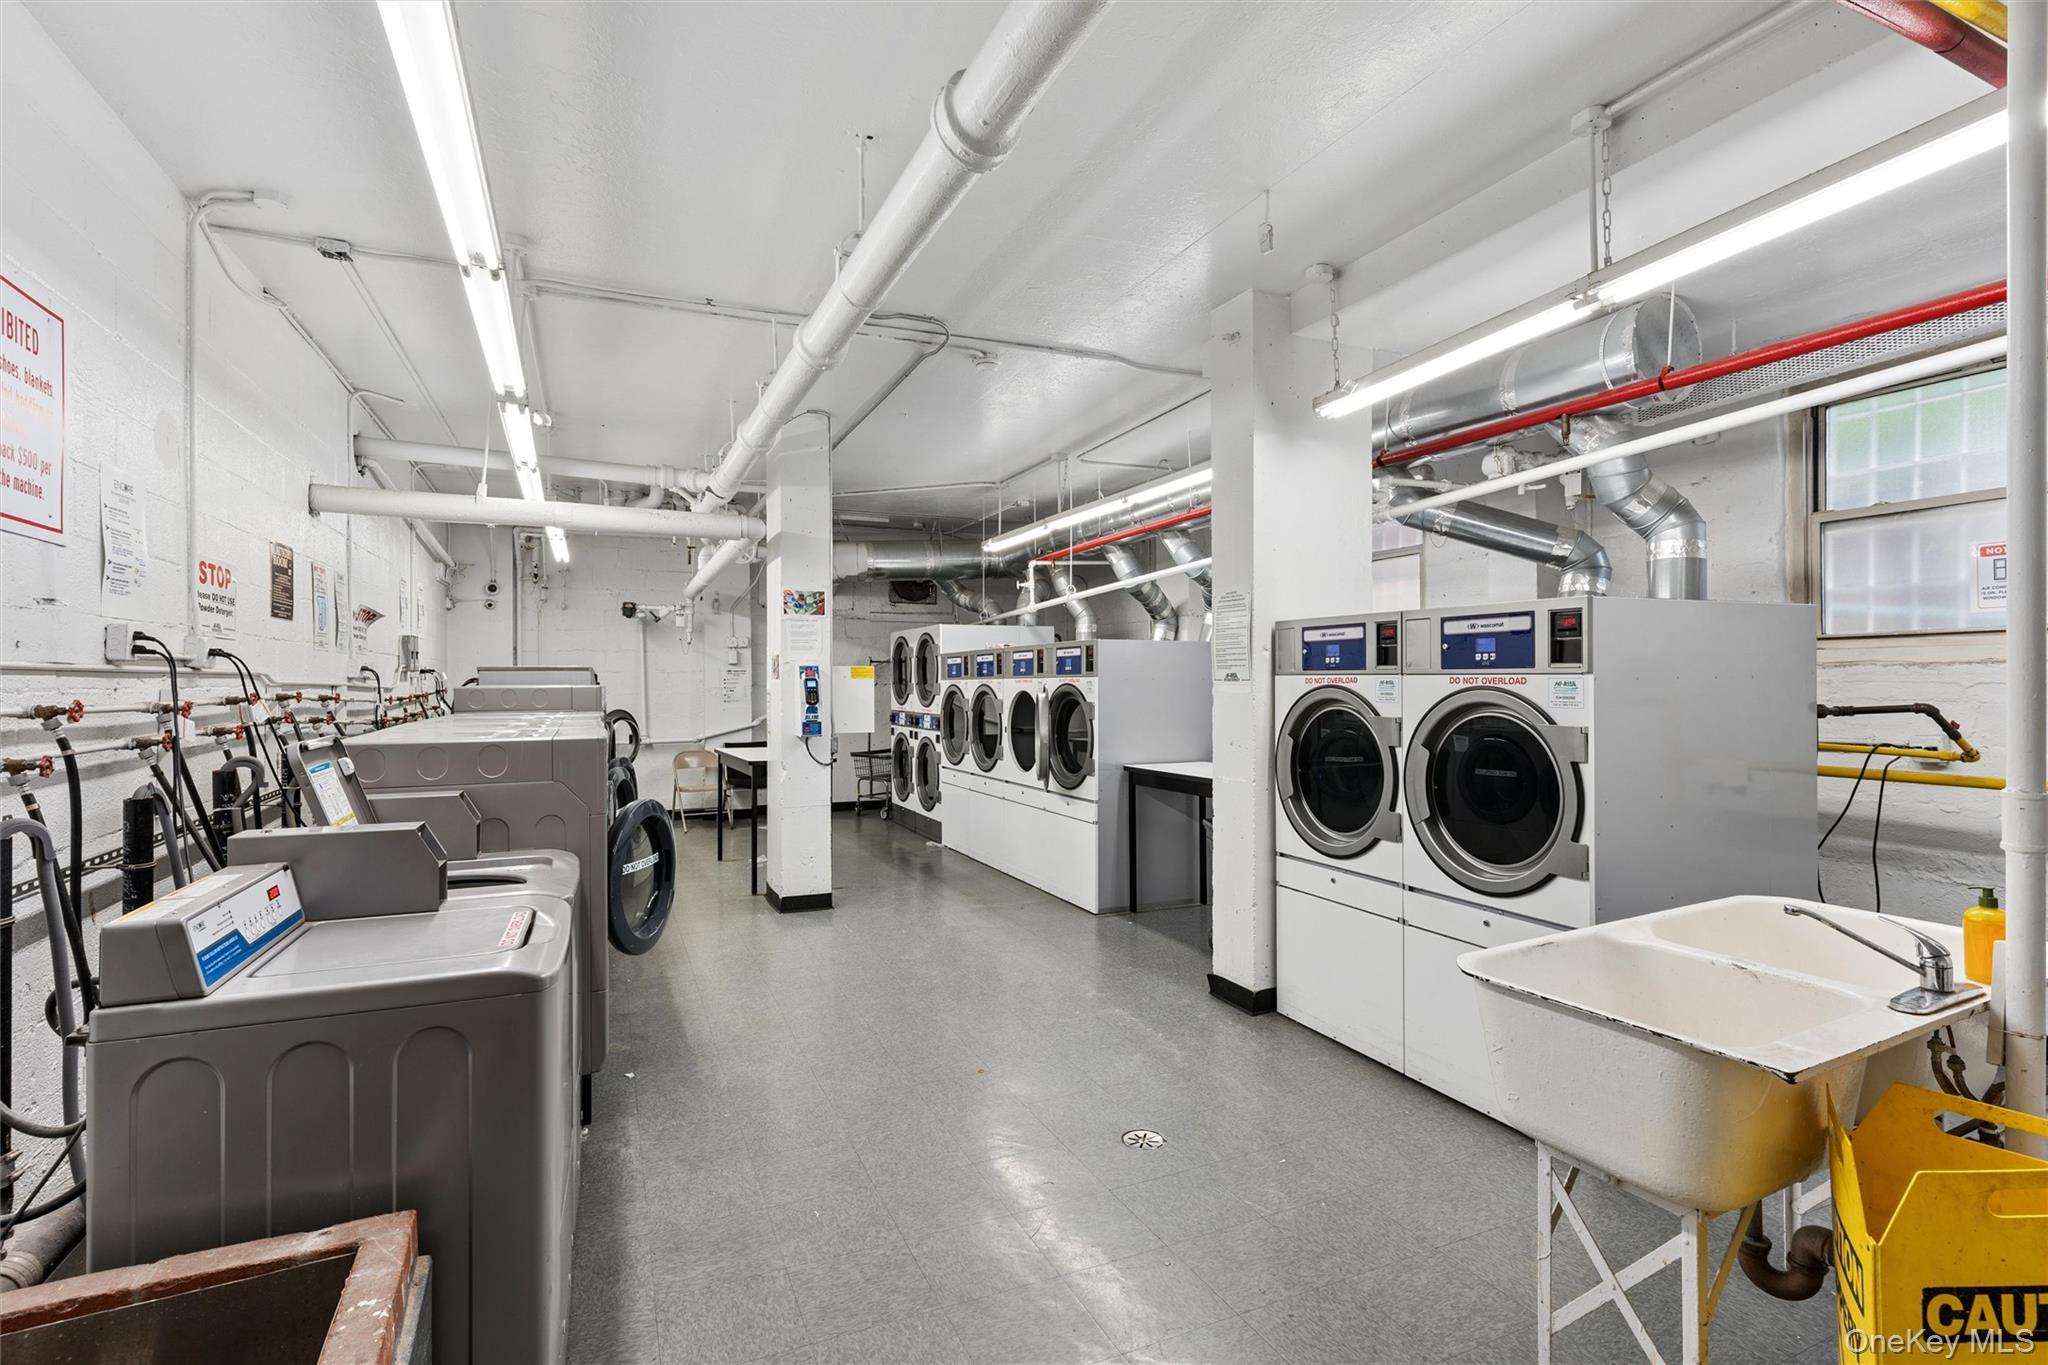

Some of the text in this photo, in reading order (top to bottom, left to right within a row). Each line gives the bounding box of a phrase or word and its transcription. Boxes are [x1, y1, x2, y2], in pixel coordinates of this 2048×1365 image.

[18, 445, 38, 471] $500
[40, 459, 52, 477] per
[199, 560, 232, 590] STOP
[1327, 676, 1358, 684] OVERLOAD
[1449, 676, 1527, 685] DO NOT OVERLOAD
[1926, 1292, 2048, 1337] CAU
